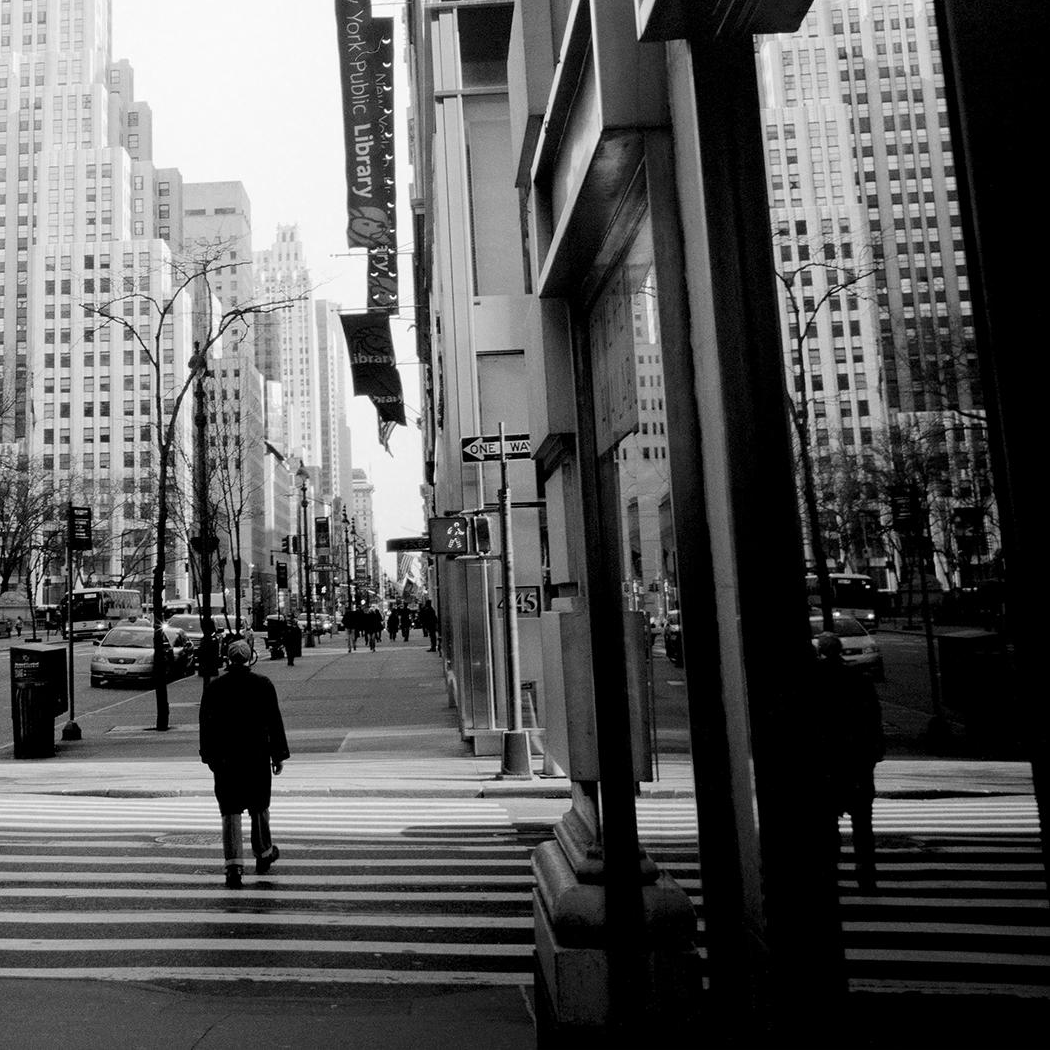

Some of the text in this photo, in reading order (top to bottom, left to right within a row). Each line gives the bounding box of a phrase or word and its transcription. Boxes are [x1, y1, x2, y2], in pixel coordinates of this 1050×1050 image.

[346, 10, 366, 52] York
[350, 60, 370, 115] Public
[352, 123, 374, 197] Library
[470, 443, 496, 454] ONE
